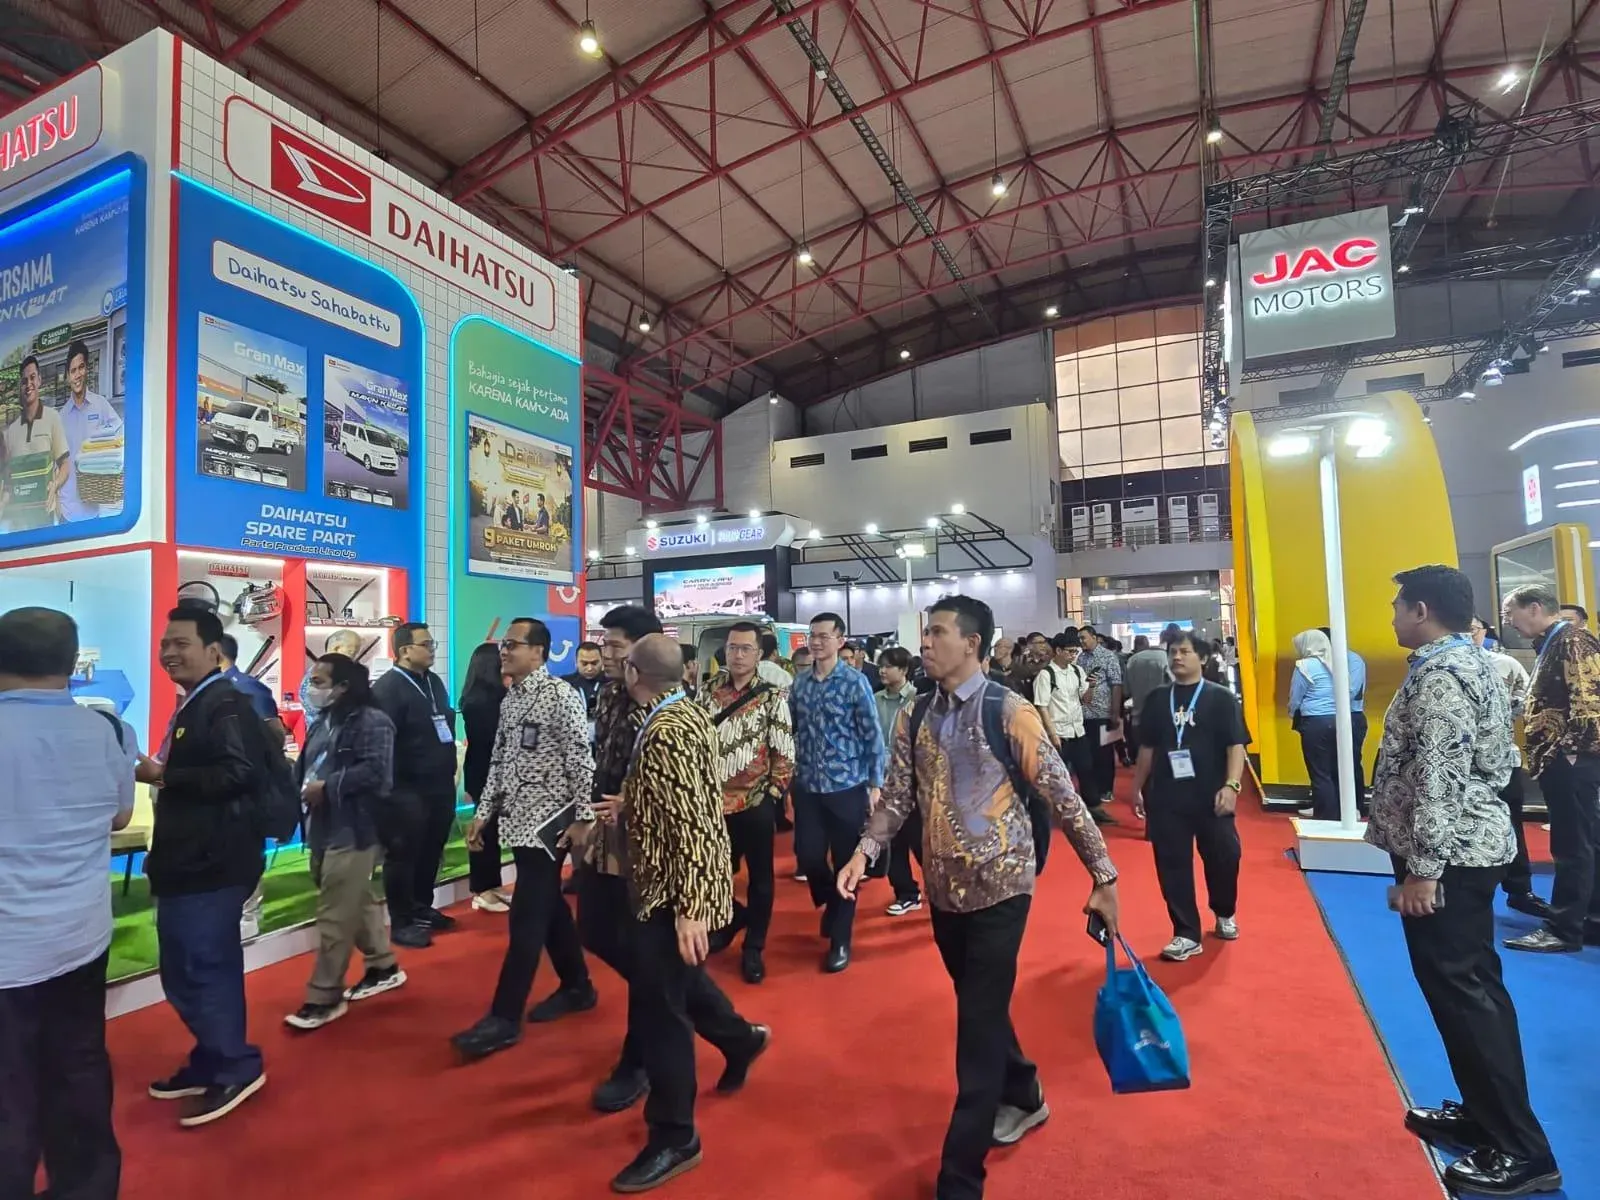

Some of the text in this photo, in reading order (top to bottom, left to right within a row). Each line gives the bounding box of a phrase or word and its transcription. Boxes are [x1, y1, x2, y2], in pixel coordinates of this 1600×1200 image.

[388, 203, 534, 307] DAIHATSU
[1253, 239, 1378, 284] JAC
[228, 256, 391, 333] Daihatsu Sahabatku
[1254, 275, 1382, 315] MOTORS
[233, 341, 271, 364] Gran
[274, 354, 305, 376] Max
[366, 380, 389, 396] Gran
[389, 387, 408, 401] Max
[468, 361, 568, 405] Bahagia sejak pertama
[469, 381, 512, 406] KARENA
[550, 407, 570, 422] ADA
[261, 504, 347, 528] DAIHATSU
[241, 538, 274, 550] Parts
[275, 542, 319, 554] Product
[341, 549, 357, 559] Up
[246, 521, 356, 547] SPARE PART
[483, 528, 557, 552] 9 PAKET UMROH
[659, 533, 707, 547] SUZUKI
